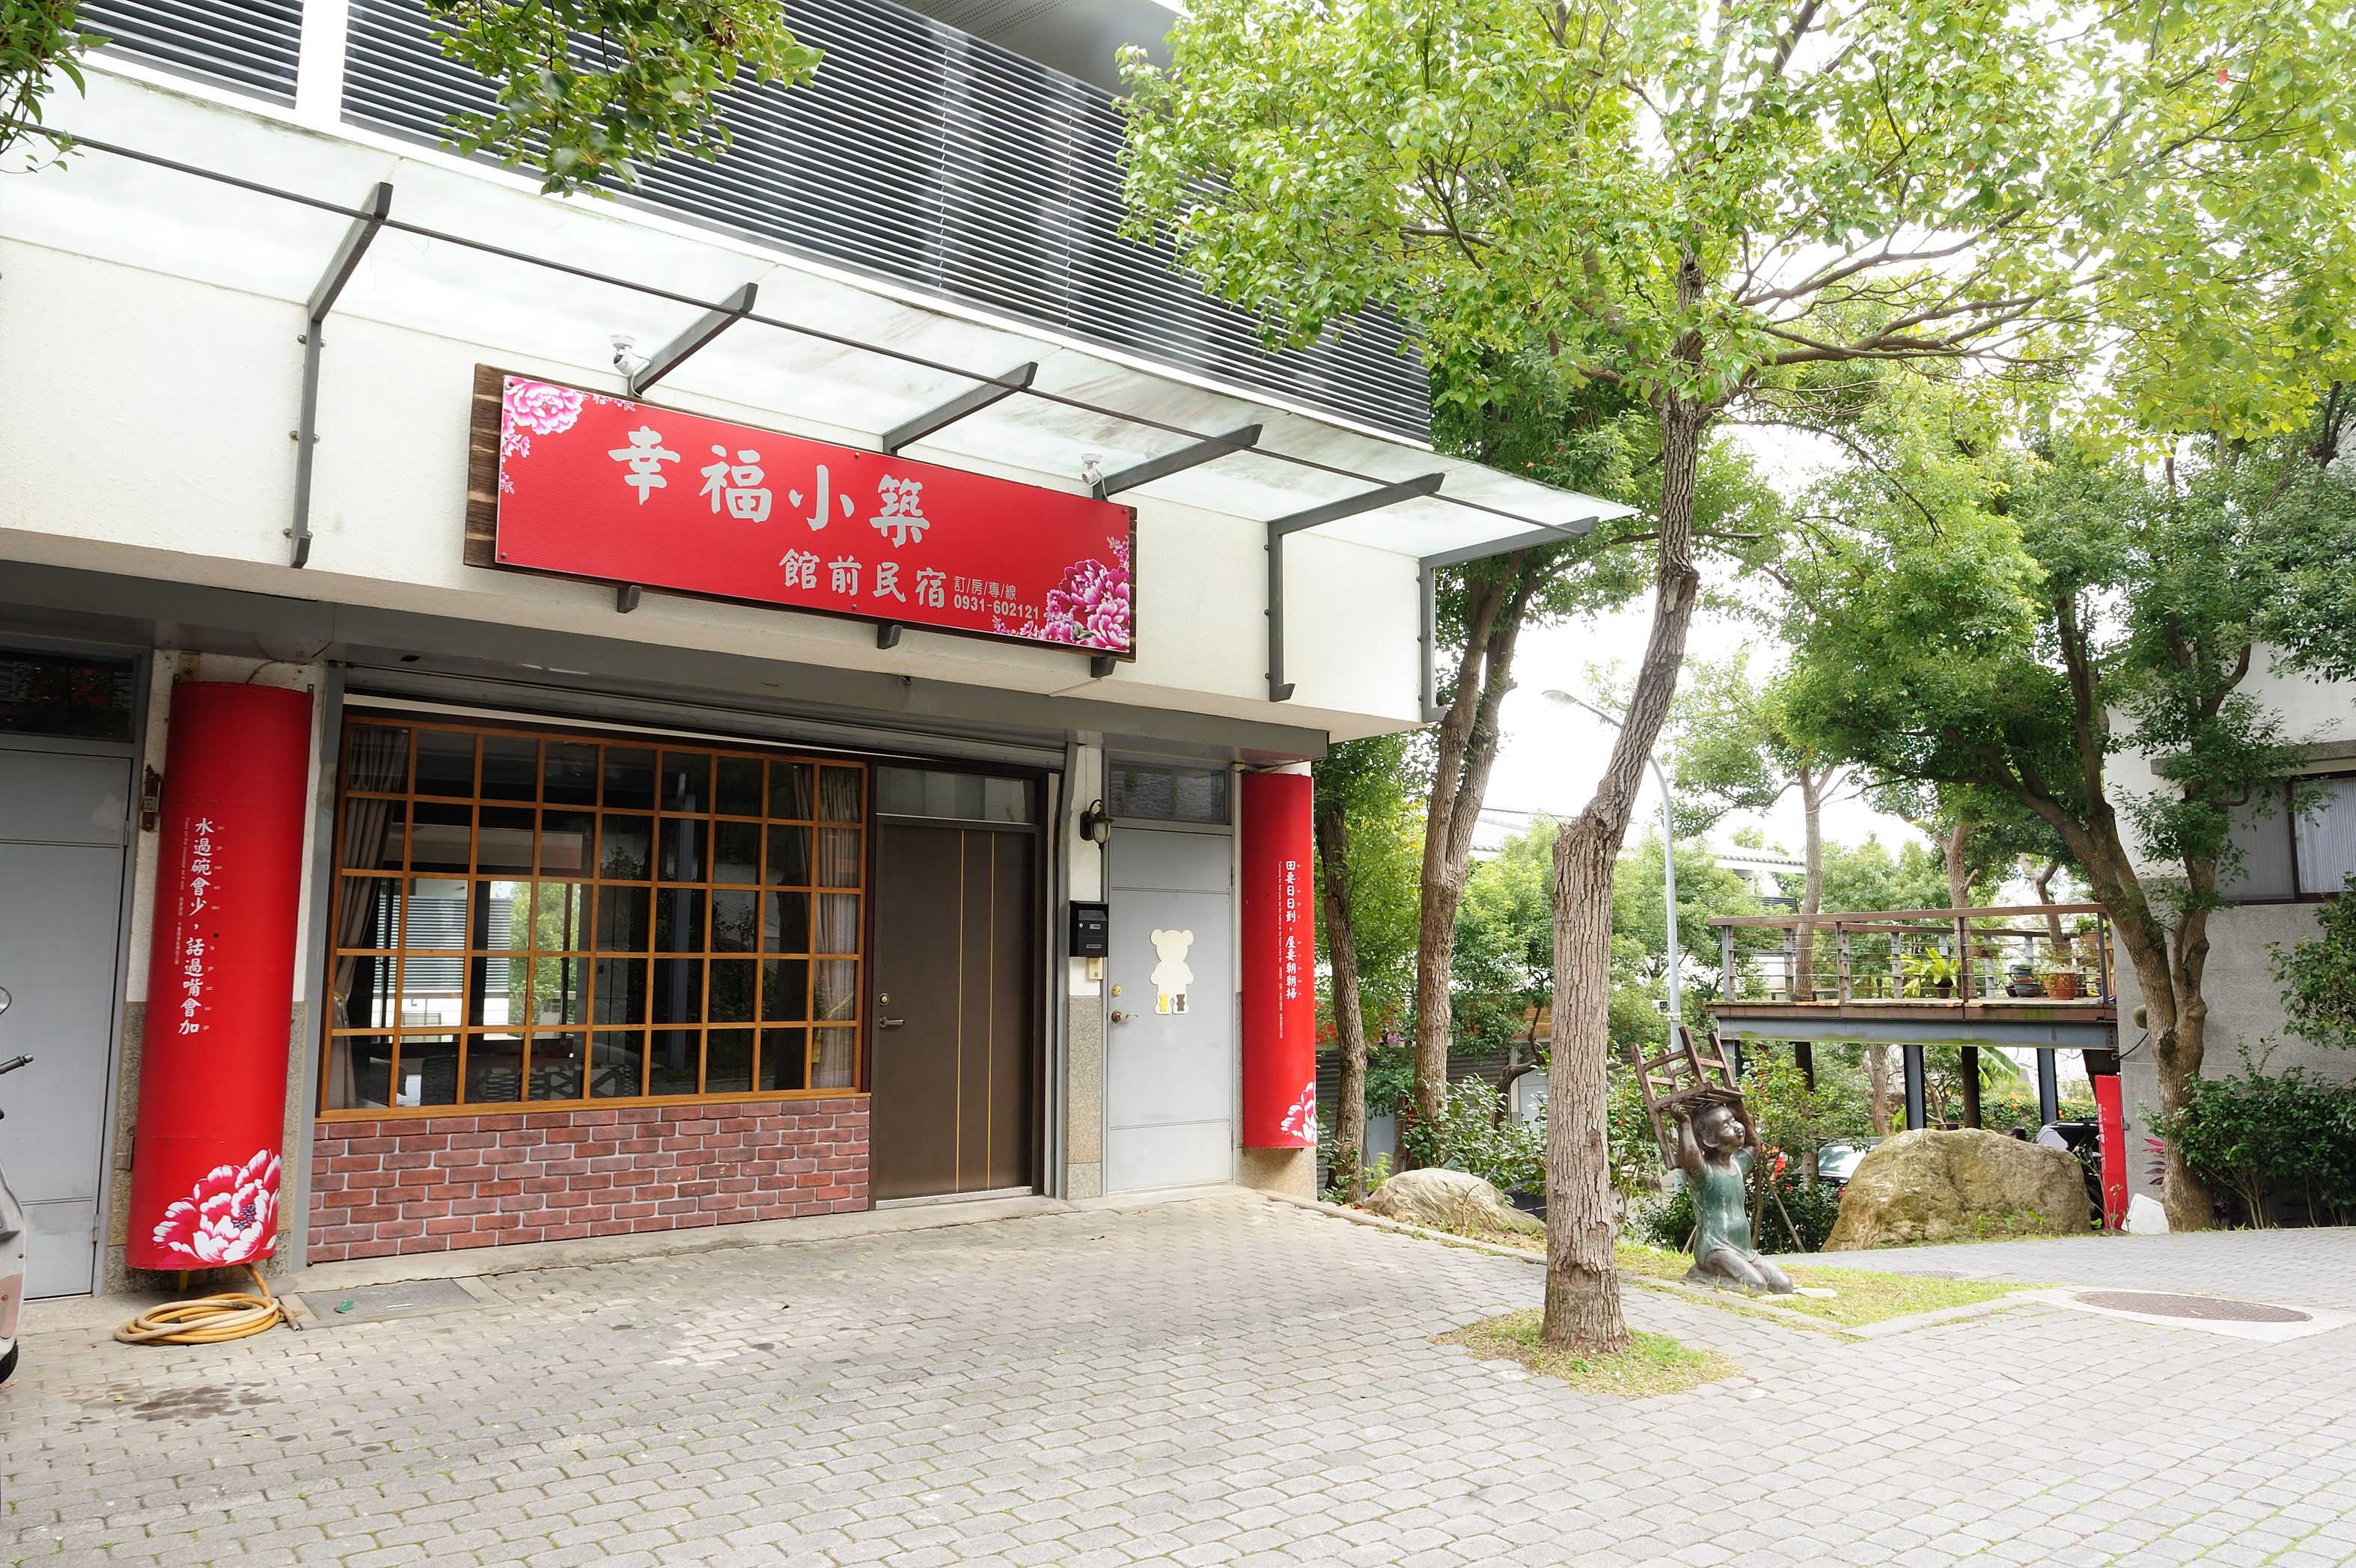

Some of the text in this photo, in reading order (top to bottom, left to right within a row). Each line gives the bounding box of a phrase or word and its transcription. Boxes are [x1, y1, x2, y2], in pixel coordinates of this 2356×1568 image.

[608, 424, 932, 548] 幸福小築
[778, 547, 947, 608] 館前民宿
[953, 593, 1039, 620] 0931-602121
